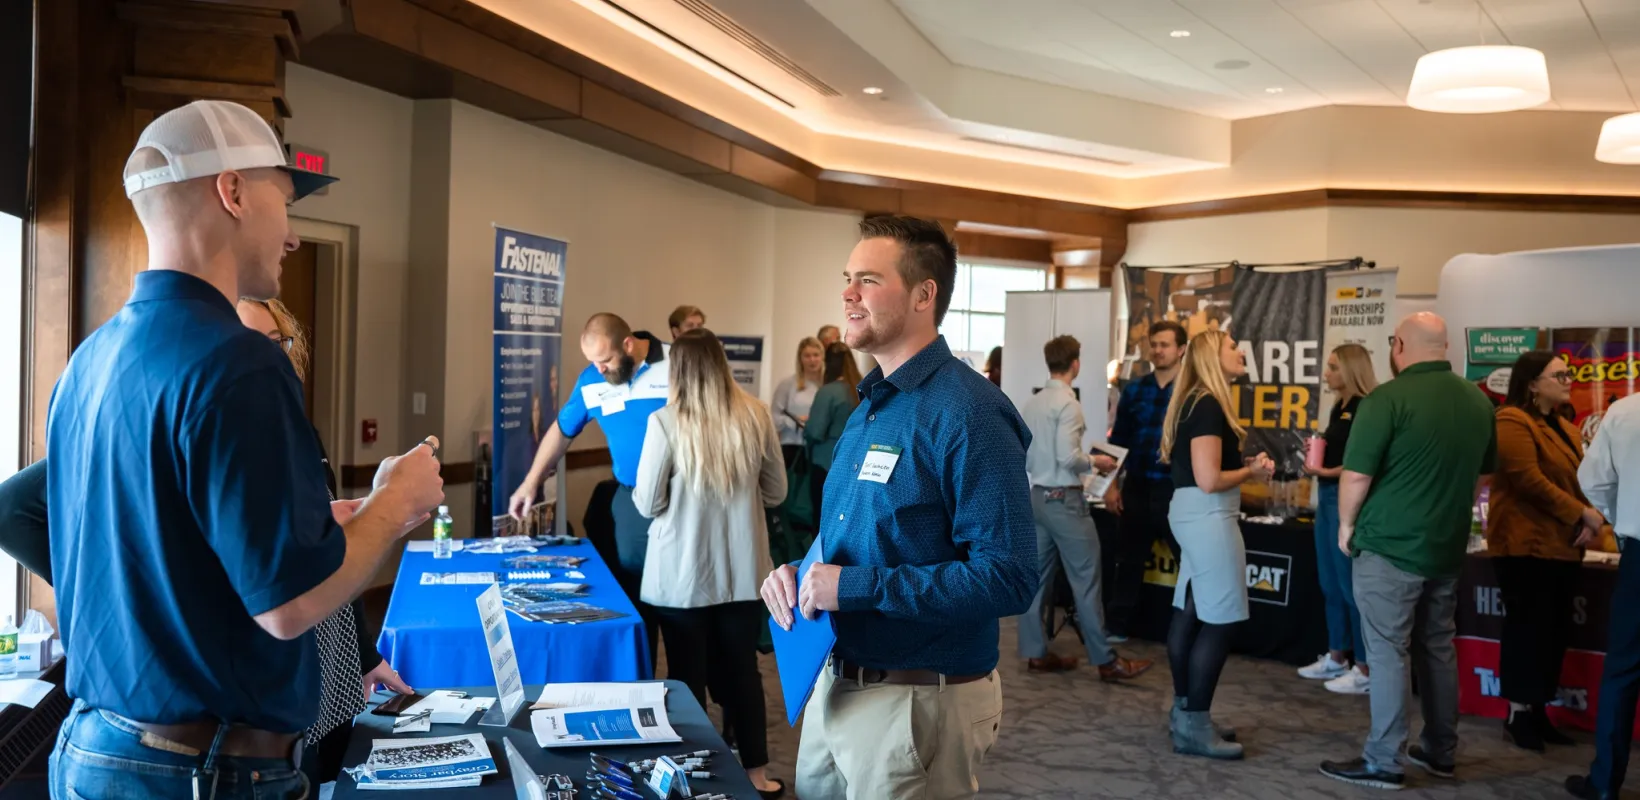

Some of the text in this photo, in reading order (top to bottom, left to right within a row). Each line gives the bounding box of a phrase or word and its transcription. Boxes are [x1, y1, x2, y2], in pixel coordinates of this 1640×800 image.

[501, 236, 561, 277] FASTENAL
[1331, 303, 1385, 316] INTERNSHIPS
[1329, 316, 1385, 326] AVAILABLE NOW
[1480, 332, 1525, 344] discover
[1474, 344, 1494, 353] new
[1238, 340, 1319, 384] ARE
[1230, 385, 1319, 430] LER.
[1246, 563, 1285, 592] CAT
[389, 771, 427, 779] Story
[430, 764, 490, 779] Graybar
